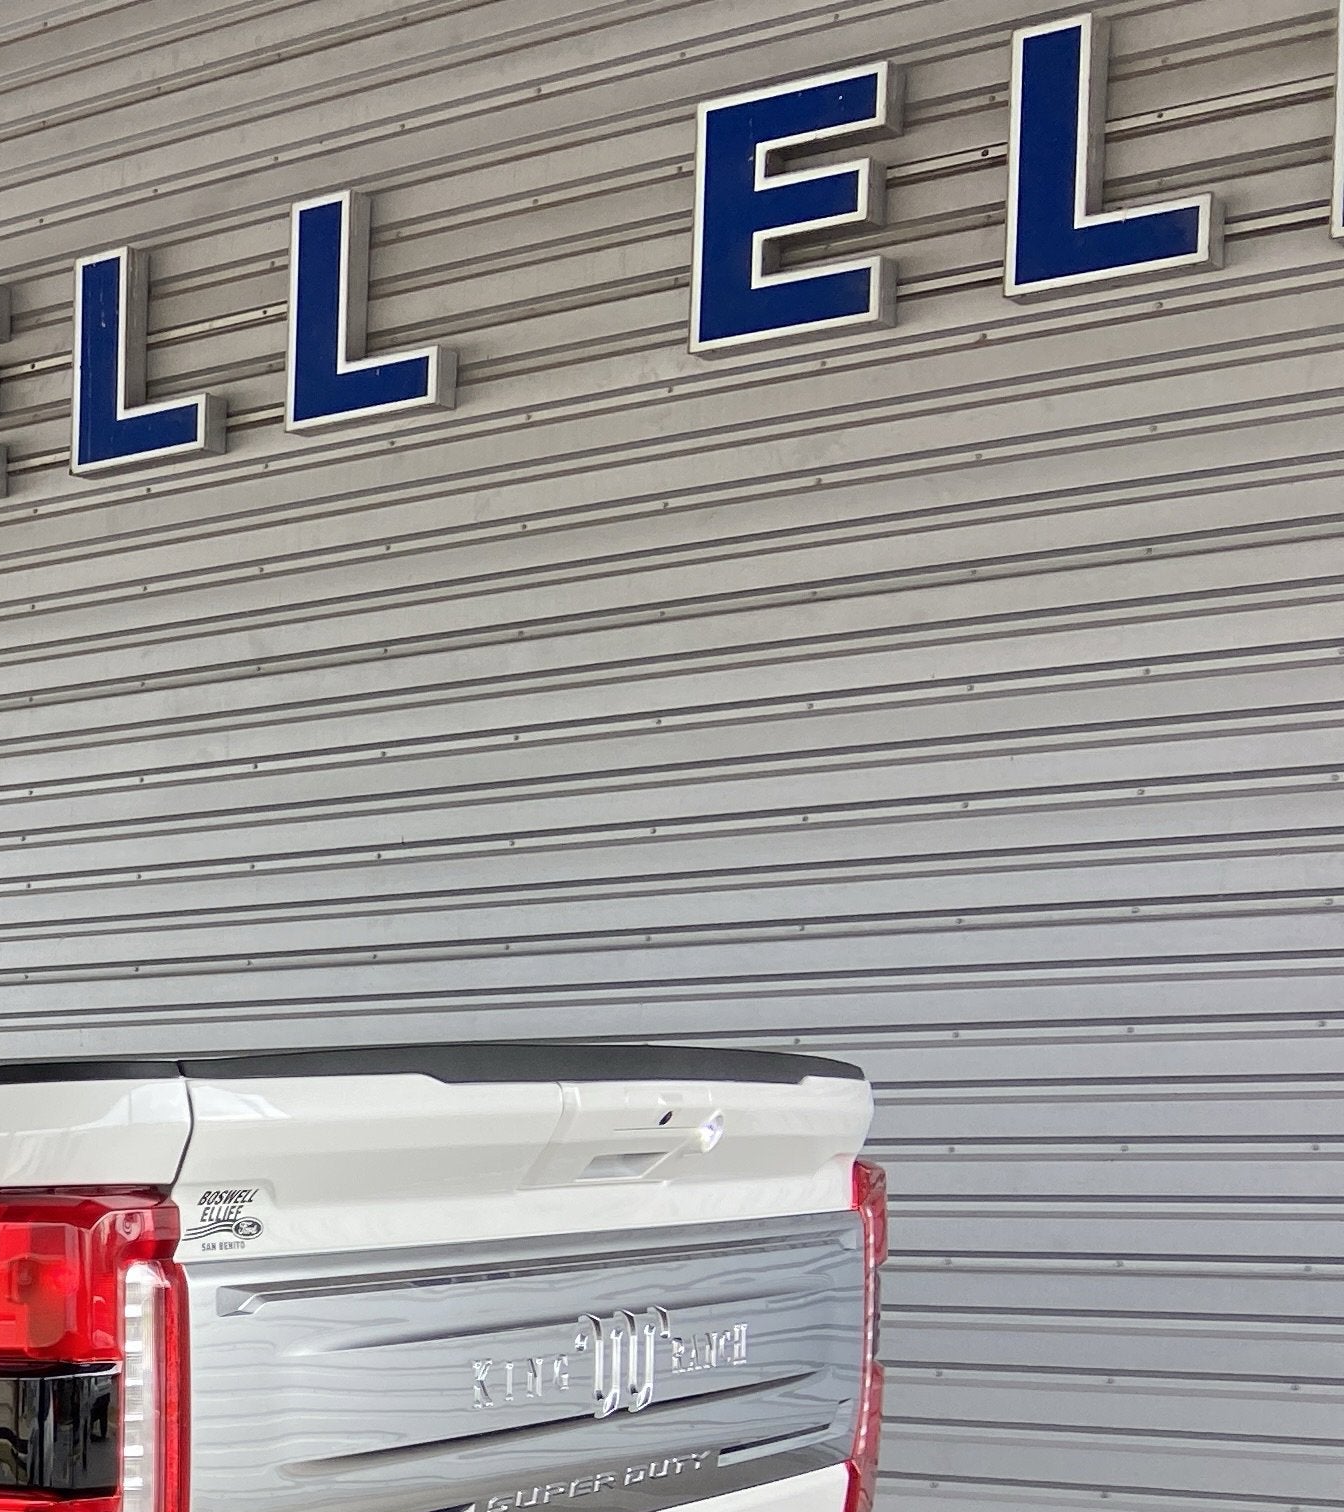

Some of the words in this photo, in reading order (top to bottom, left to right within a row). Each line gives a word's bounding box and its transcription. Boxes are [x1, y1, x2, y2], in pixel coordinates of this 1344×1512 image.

[688, 4, 1344, 354] EL
[197, 1188, 259, 1206] BOSWELL
[201, 1241, 217, 1252] SAN
[219, 1240, 246, 1251] BENITO
[472, 1353, 569, 1409] KING
[671, 1323, 748, 1374] RANCH
[624, 1450, 712, 1487] DUTY
